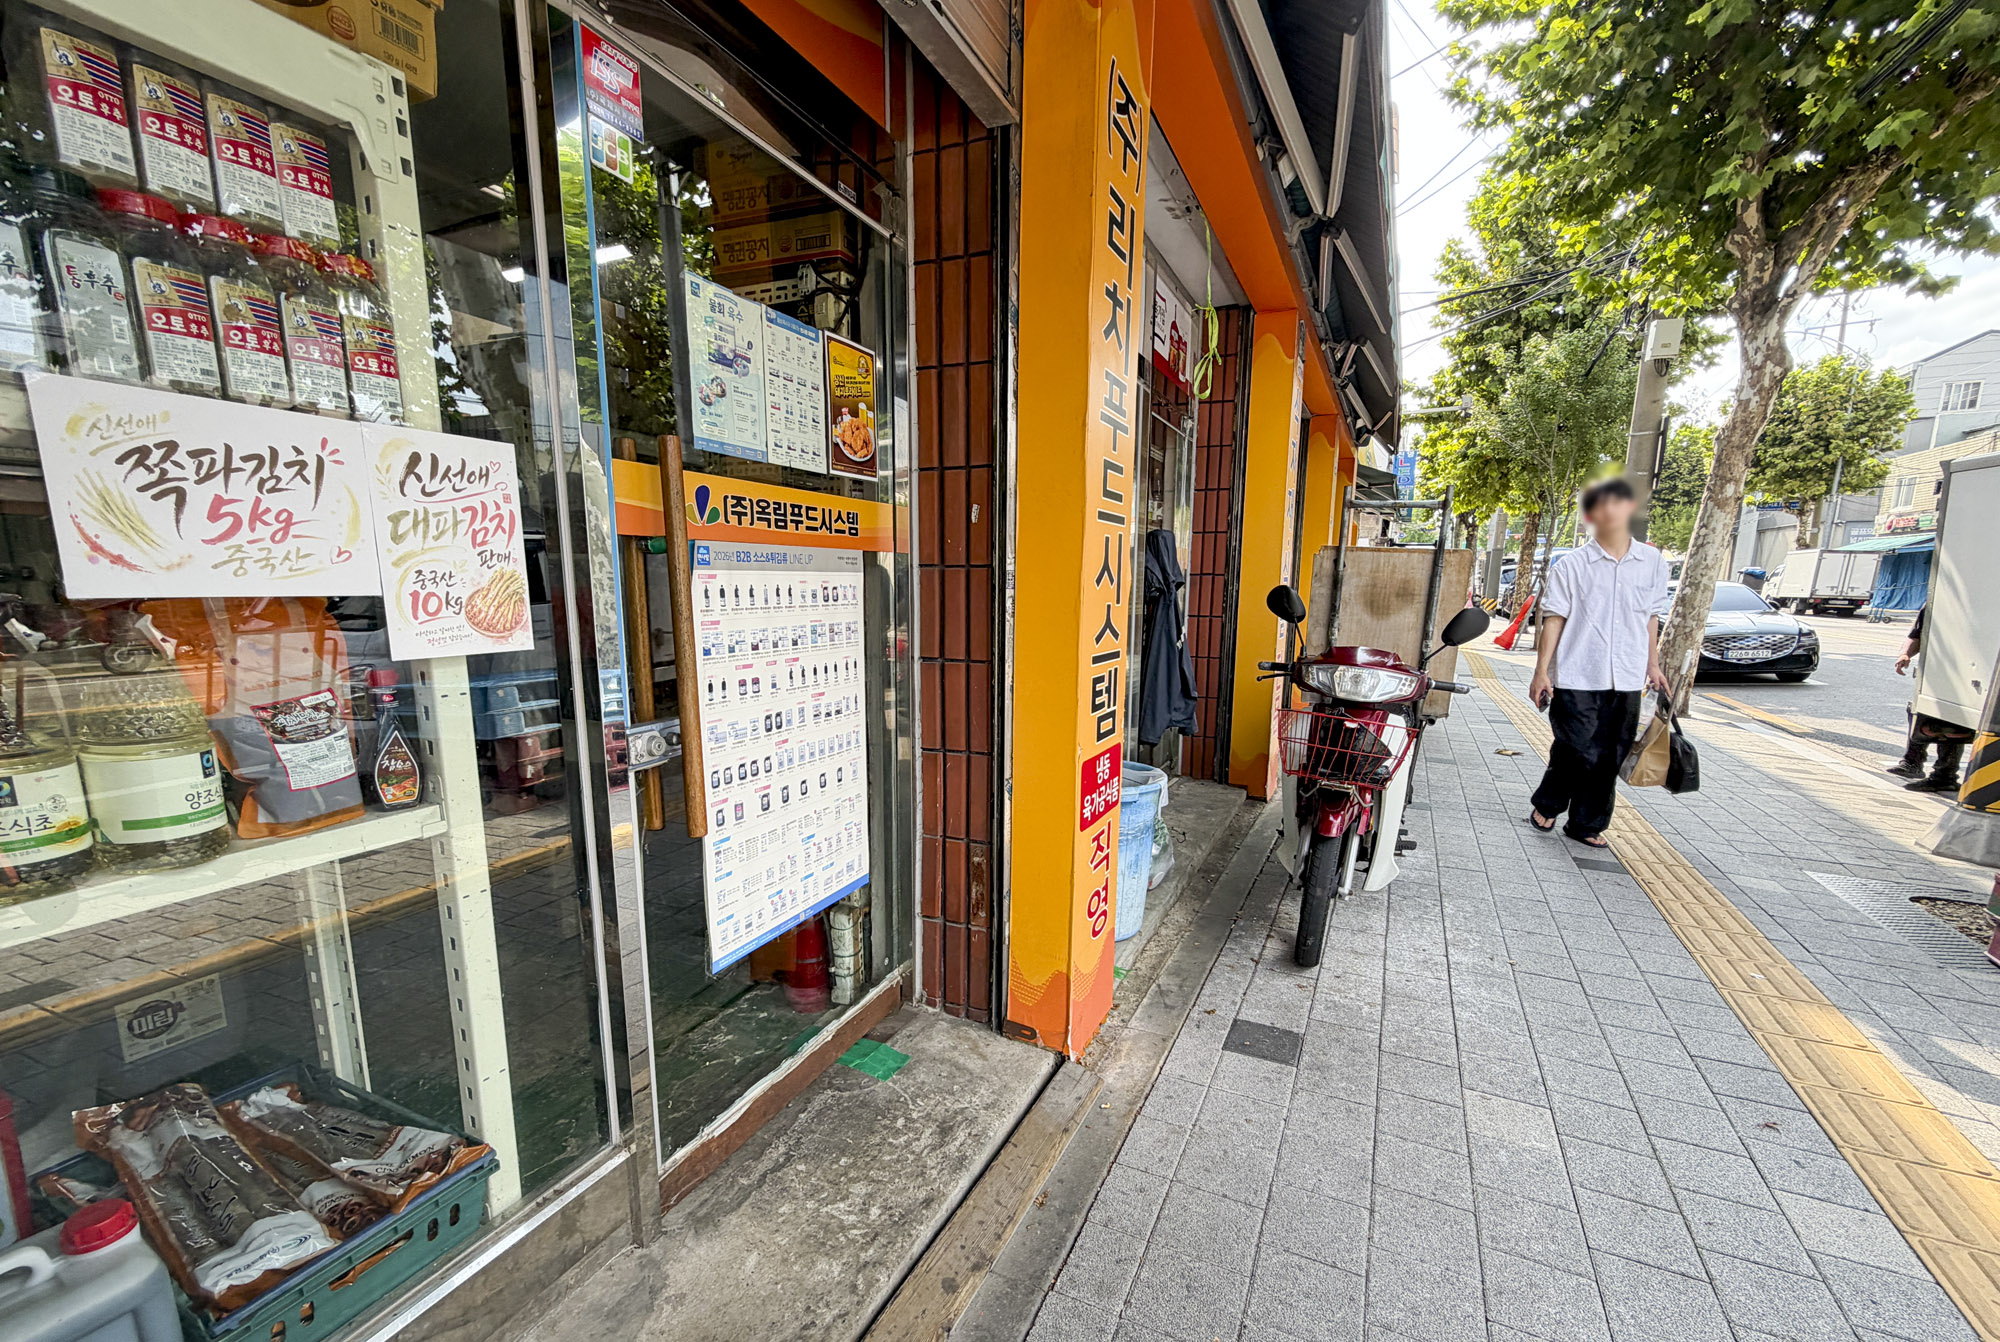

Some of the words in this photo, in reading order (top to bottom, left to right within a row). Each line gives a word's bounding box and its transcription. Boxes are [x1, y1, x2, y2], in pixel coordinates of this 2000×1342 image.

[57, 84, 97, 111] 오토
[97, 90, 120, 105] OTTO
[100, 102, 123, 121] 후추
[145, 116, 181, 142] 오토
[182, 123, 202, 136] OTTO
[184, 133, 204, 151] 후추
[253, 146, 271, 159] OTTO
[591, 135, 629, 166] JCB
[221, 143, 253, 165] 오토
[255, 157, 273, 173] 후추
[282, 169, 312, 189] 오토
[311, 171, 328, 182] OTTO
[313, 181, 330, 195] 후추
[65, 265, 120, 295] 통후추
[187, 312, 206, 323] OTTO
[708, 297, 725, 317] 물회
[727, 305, 744, 325] 육수
[151, 312, 187, 333] 오토
[189, 322, 210, 337] 후추
[228, 329, 260, 349] 오토
[261, 330, 278, 339] OTTO
[263, 339, 280, 353] 후추
[293, 342, 323, 361] 오토
[354, 355, 380, 372] 오토
[380, 355, 394, 364] OTTO
[381, 363, 396, 376] 후추
[1090, 55, 1144, 743] (주)리치푸드시스템
[85, 412, 158, 441] 신선애
[399, 450, 490, 498] 신선애
[114, 438, 326, 540] 쪽파김치
[201, 494, 316, 546] 5kg
[723, 494, 860, 537] (주)옥림푸드시스템
[211, 545, 316, 578] 중국산
[477, 549, 511, 570] 판매
[713, 551, 735, 562] 2026년
[735, 550, 752, 563] B2B
[789, 553, 804, 565] LINE
[804, 554, 814, 565] UP
[412, 569, 457, 590] 중국산
[409, 590, 465, 621] 10kg
[1096, 752, 1111, 784] 냉동
[1082, 775, 1120, 821] 육가공식품
[1087, 818, 1112, 940] 직영
